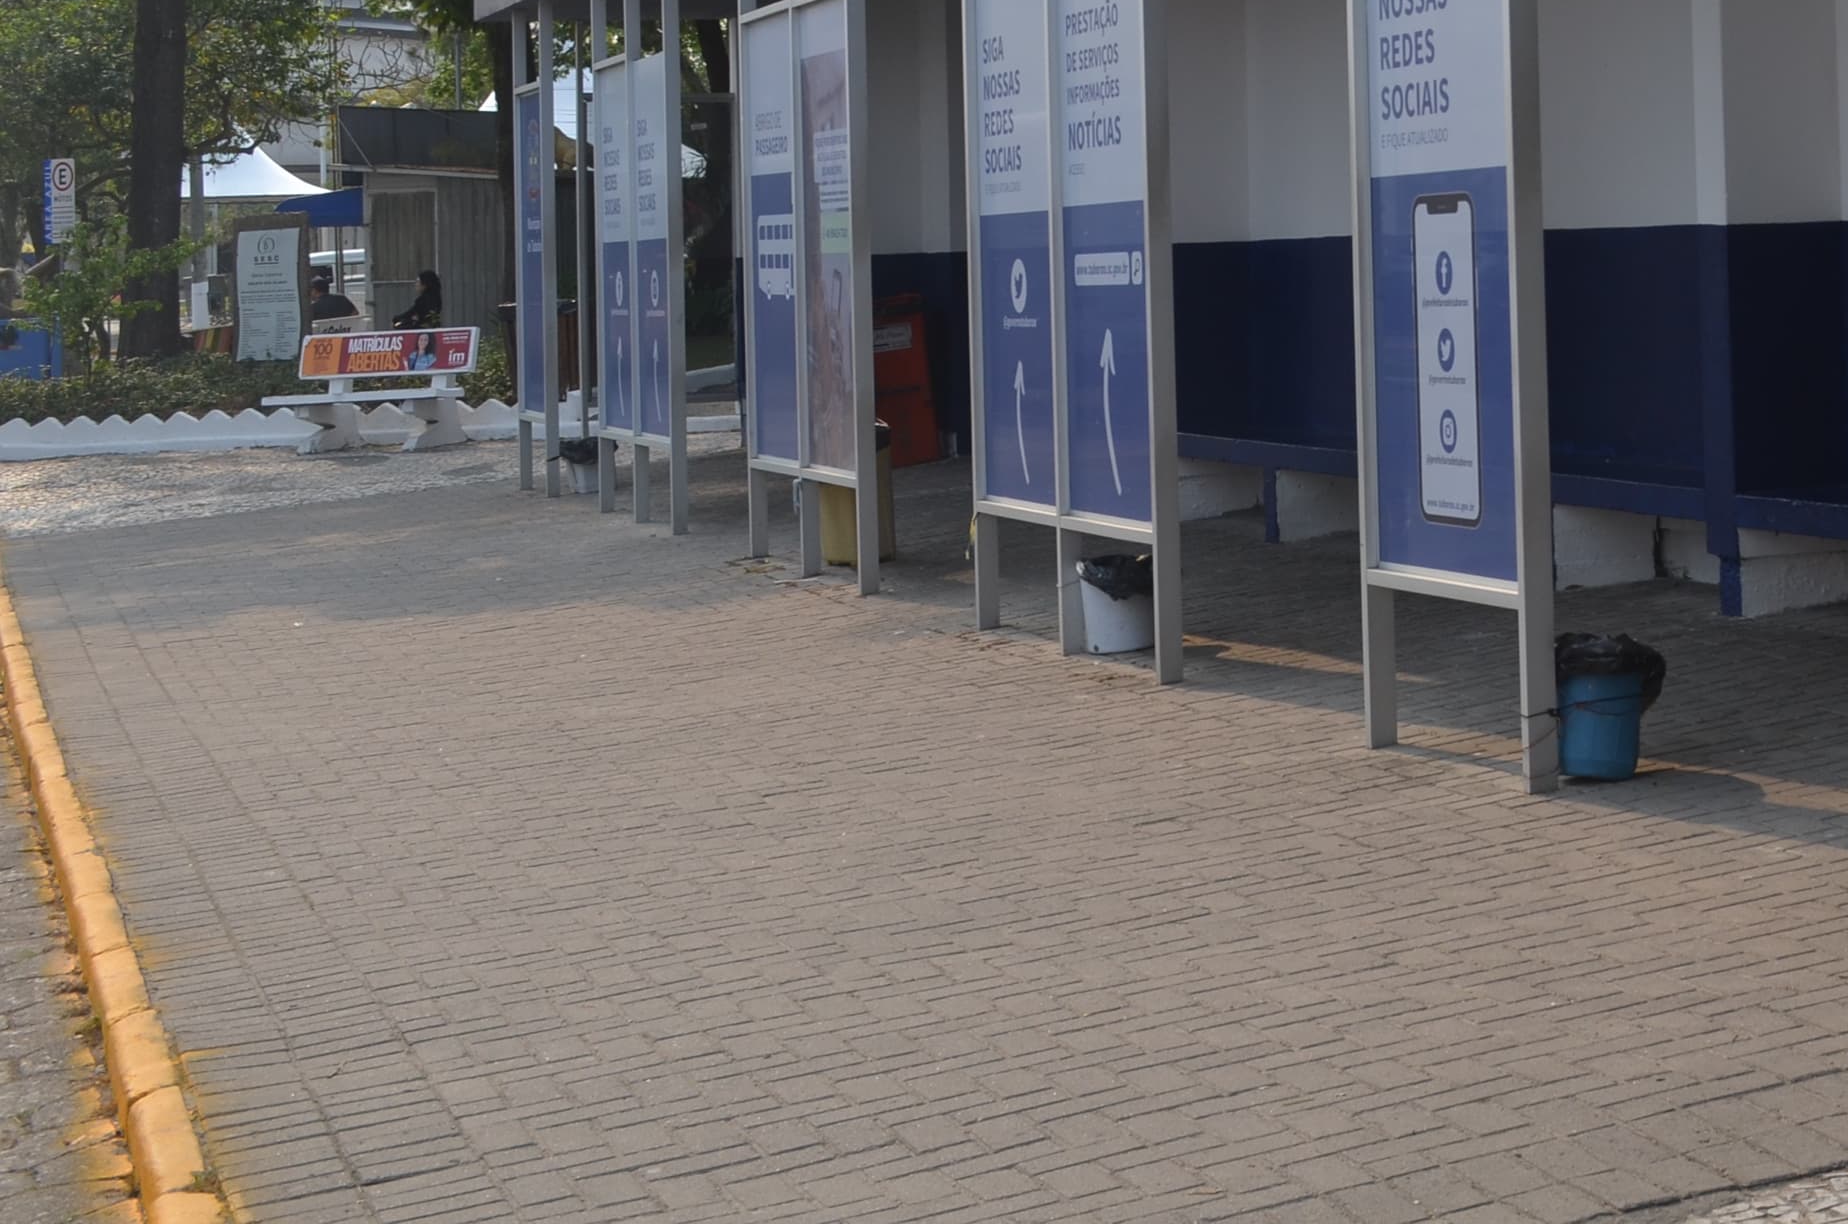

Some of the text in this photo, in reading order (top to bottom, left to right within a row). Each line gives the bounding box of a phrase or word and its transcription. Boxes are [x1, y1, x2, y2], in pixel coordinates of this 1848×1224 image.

[1065, 0, 1119, 37] PRESTAÇÃO
[983, 36, 1005, 65] SIGA
[1066, 43, 1120, 73] DE SERVIÇOS
[1380, 28, 1435, 71] REDES
[983, 70, 1021, 101] NOSSAS
[1067, 76, 1120, 105] INFORMAÇÕES
[1381, 77, 1450, 121] SOCIAIS
[984, 108, 1015, 137] REDES
[1068, 112, 1122, 152] NOTÍCIAS
[984, 145, 1022, 174] SOCIAIS
[59, 168, 67, 185] E
[347, 335, 404, 354] MATRÍCULAS
[346, 351, 401, 373] ABERTAS
